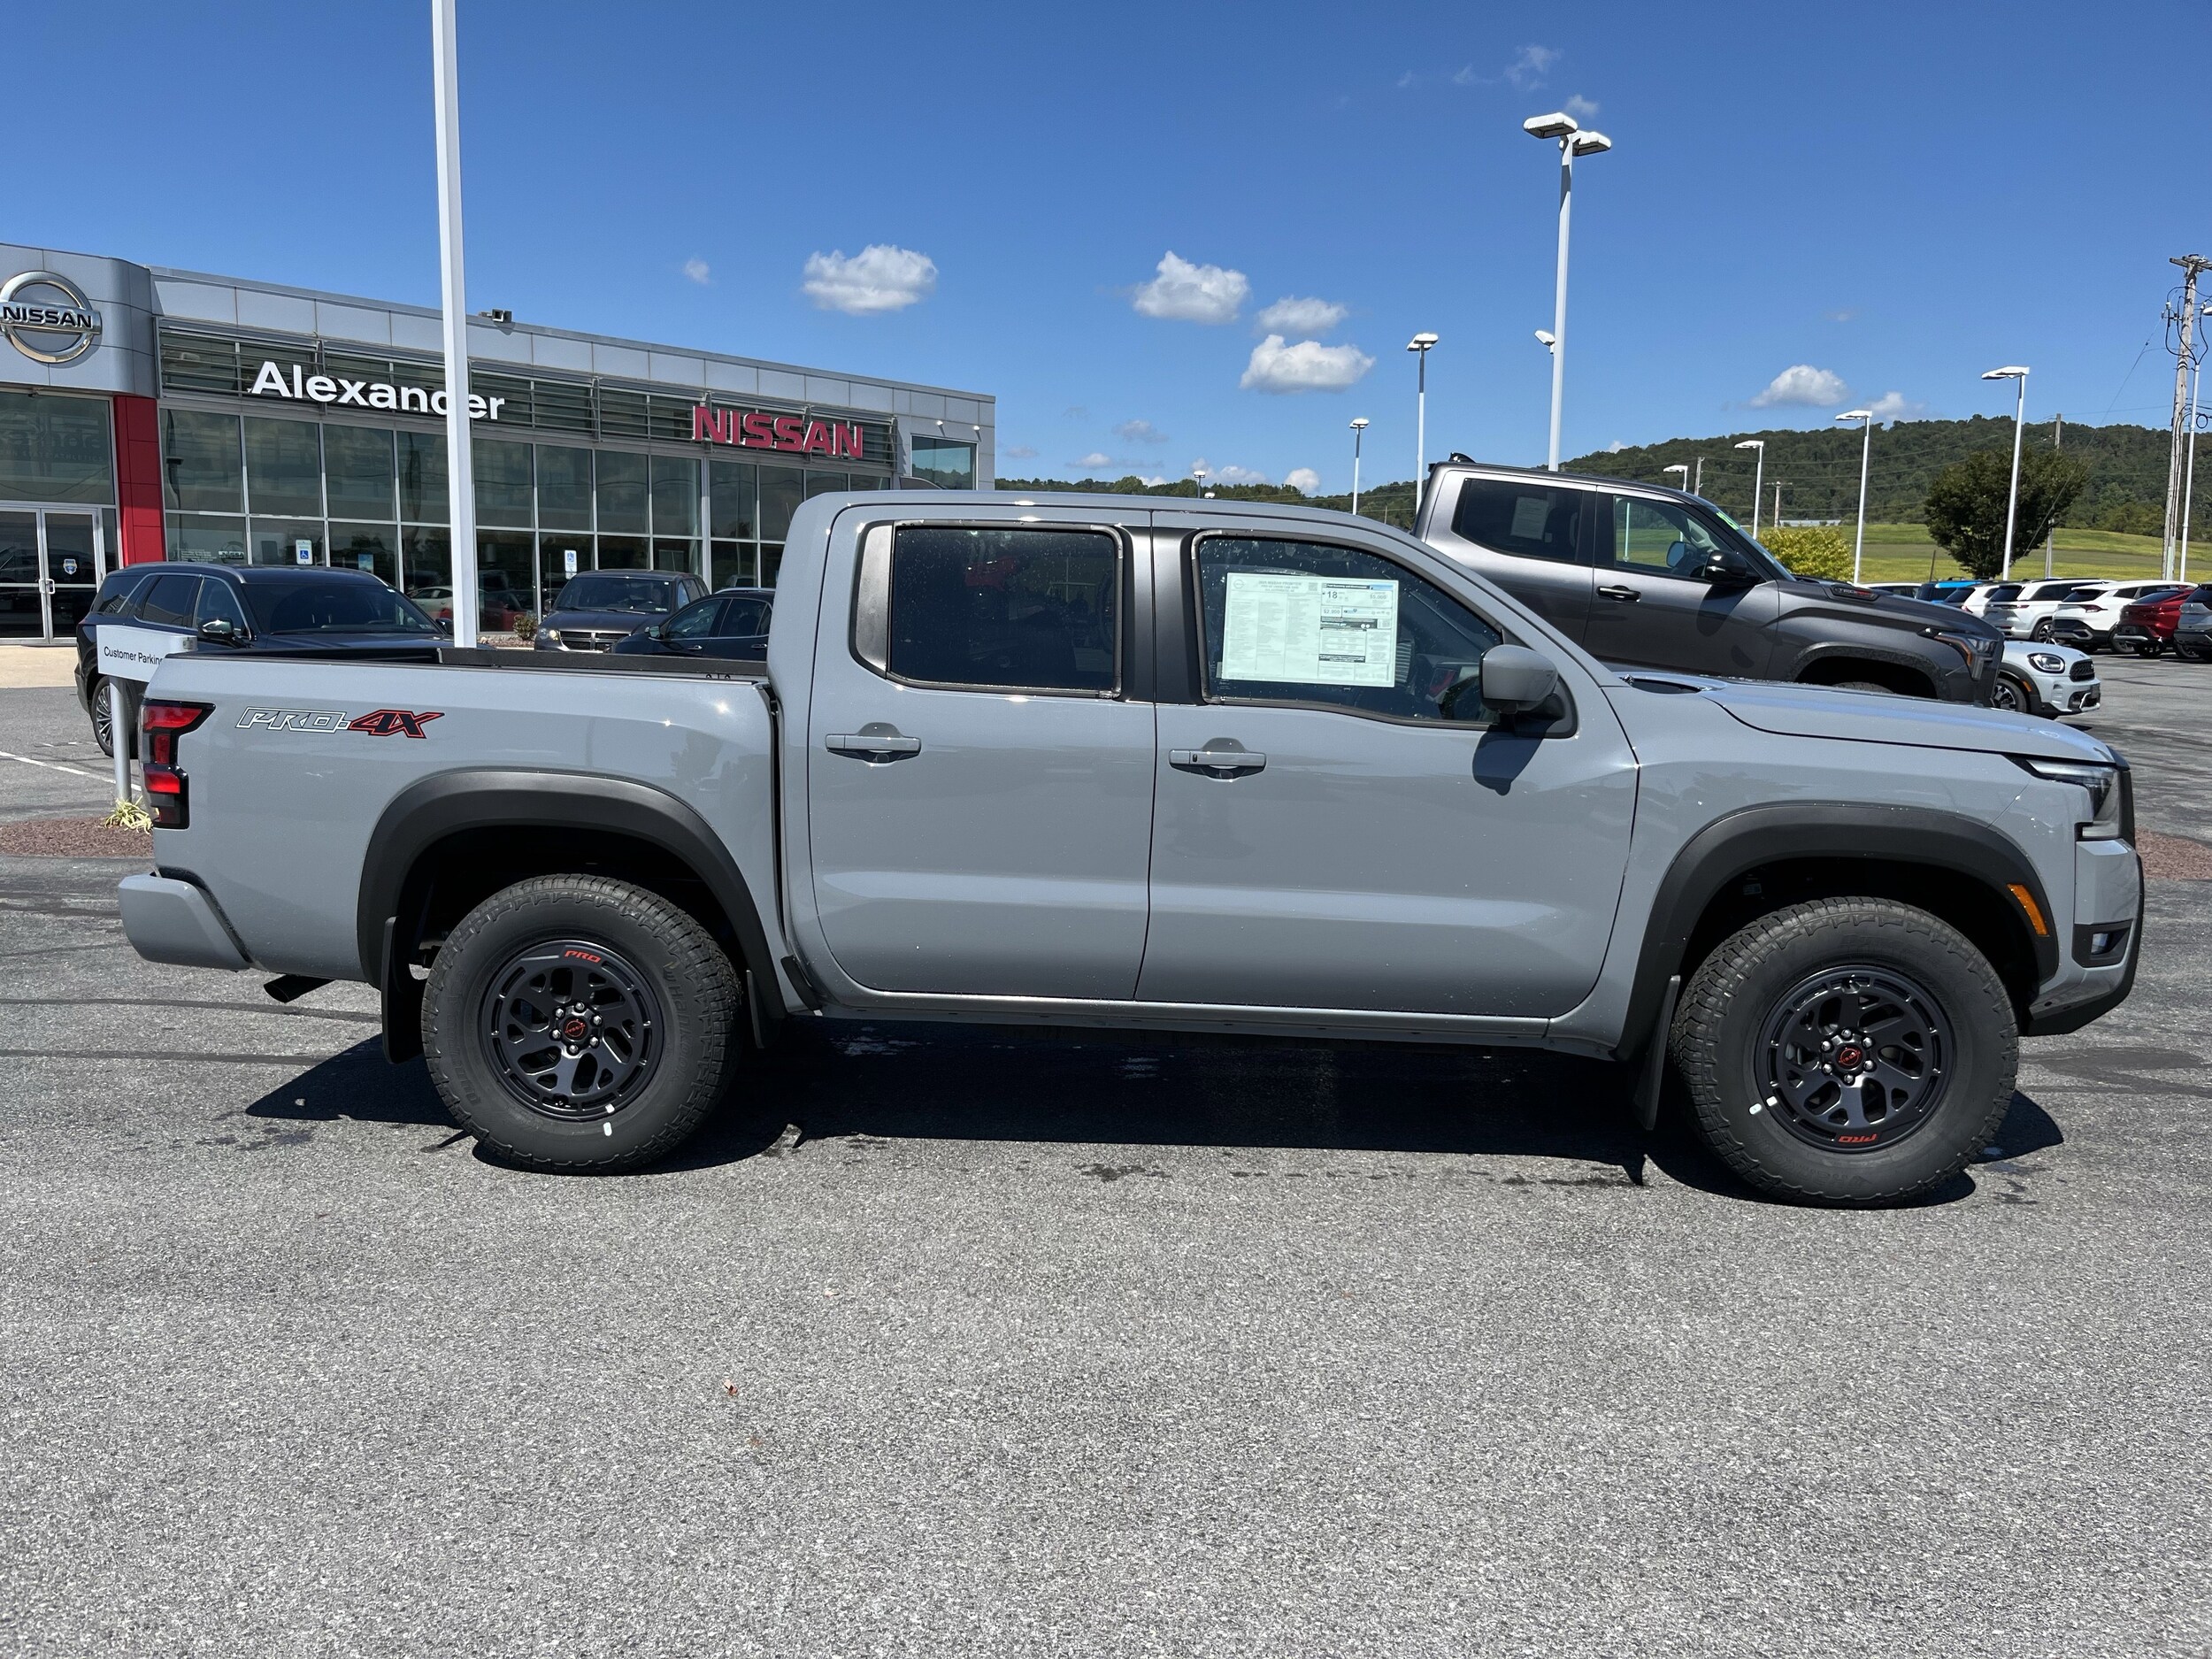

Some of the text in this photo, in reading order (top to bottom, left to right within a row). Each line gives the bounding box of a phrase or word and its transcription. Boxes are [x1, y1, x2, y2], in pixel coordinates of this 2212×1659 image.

[3, 306, 93, 328] NISSAN
[693, 405, 864, 458] NISSAN
[104, 646, 137, 661] Customer
[234, 706, 445, 739] PRO-4X
[565, 950, 602, 964] PRO
[1838, 1133, 1877, 1143] PRO
